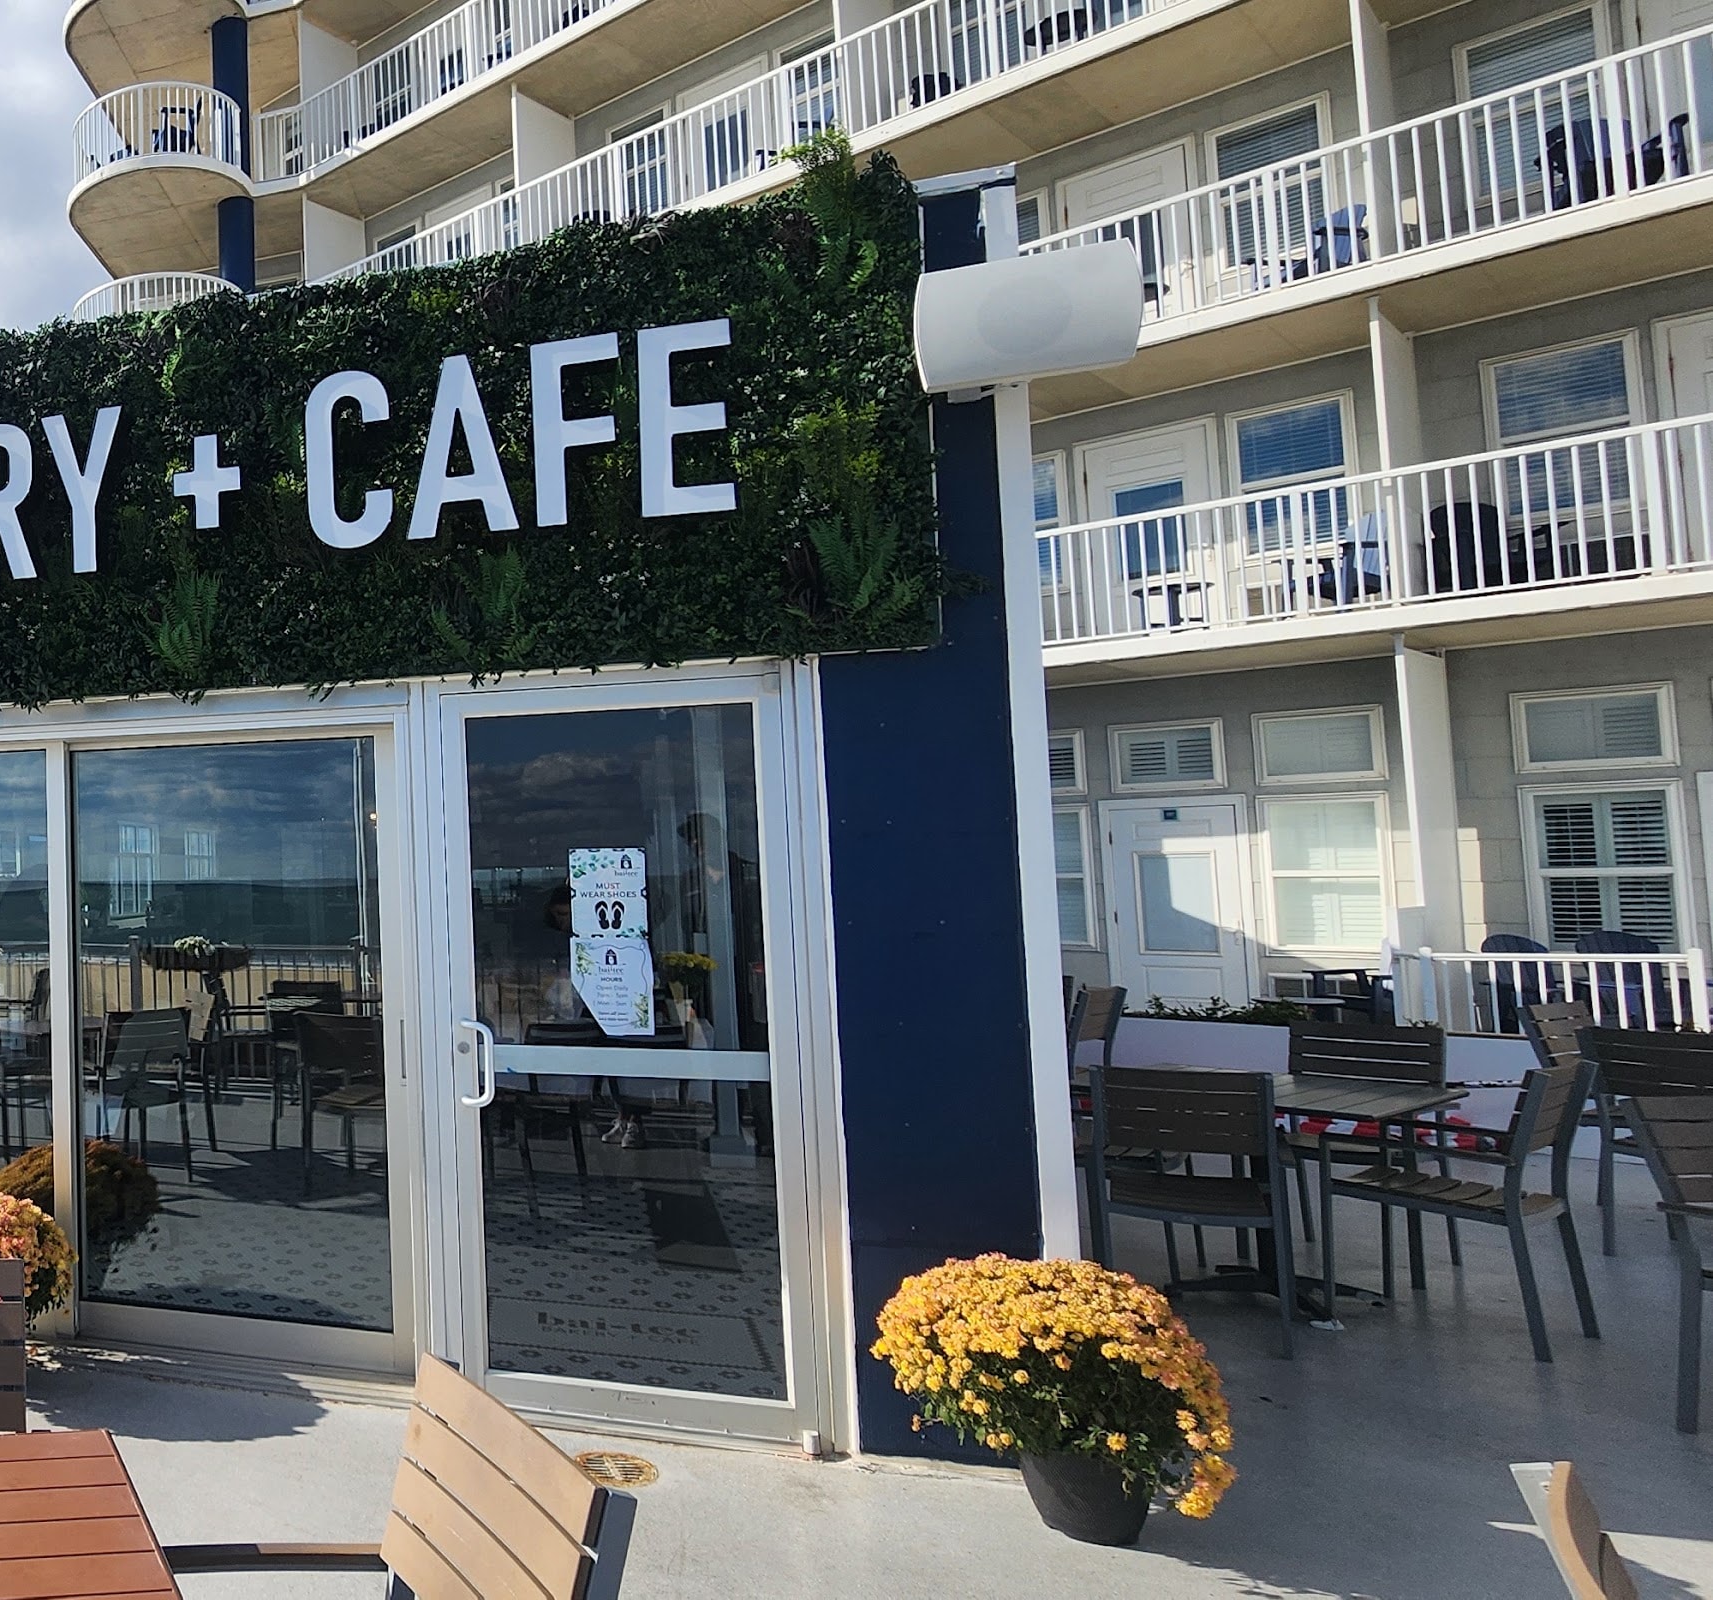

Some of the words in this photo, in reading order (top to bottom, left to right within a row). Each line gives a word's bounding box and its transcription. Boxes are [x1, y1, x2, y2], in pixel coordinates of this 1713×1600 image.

[173, 434, 241, 530] +
[305, 318, 738, 550] CAFE
[595, 882, 621, 890] MUST
[580, 890, 606, 898] WEAR
[607, 890, 637, 898] SHOES
